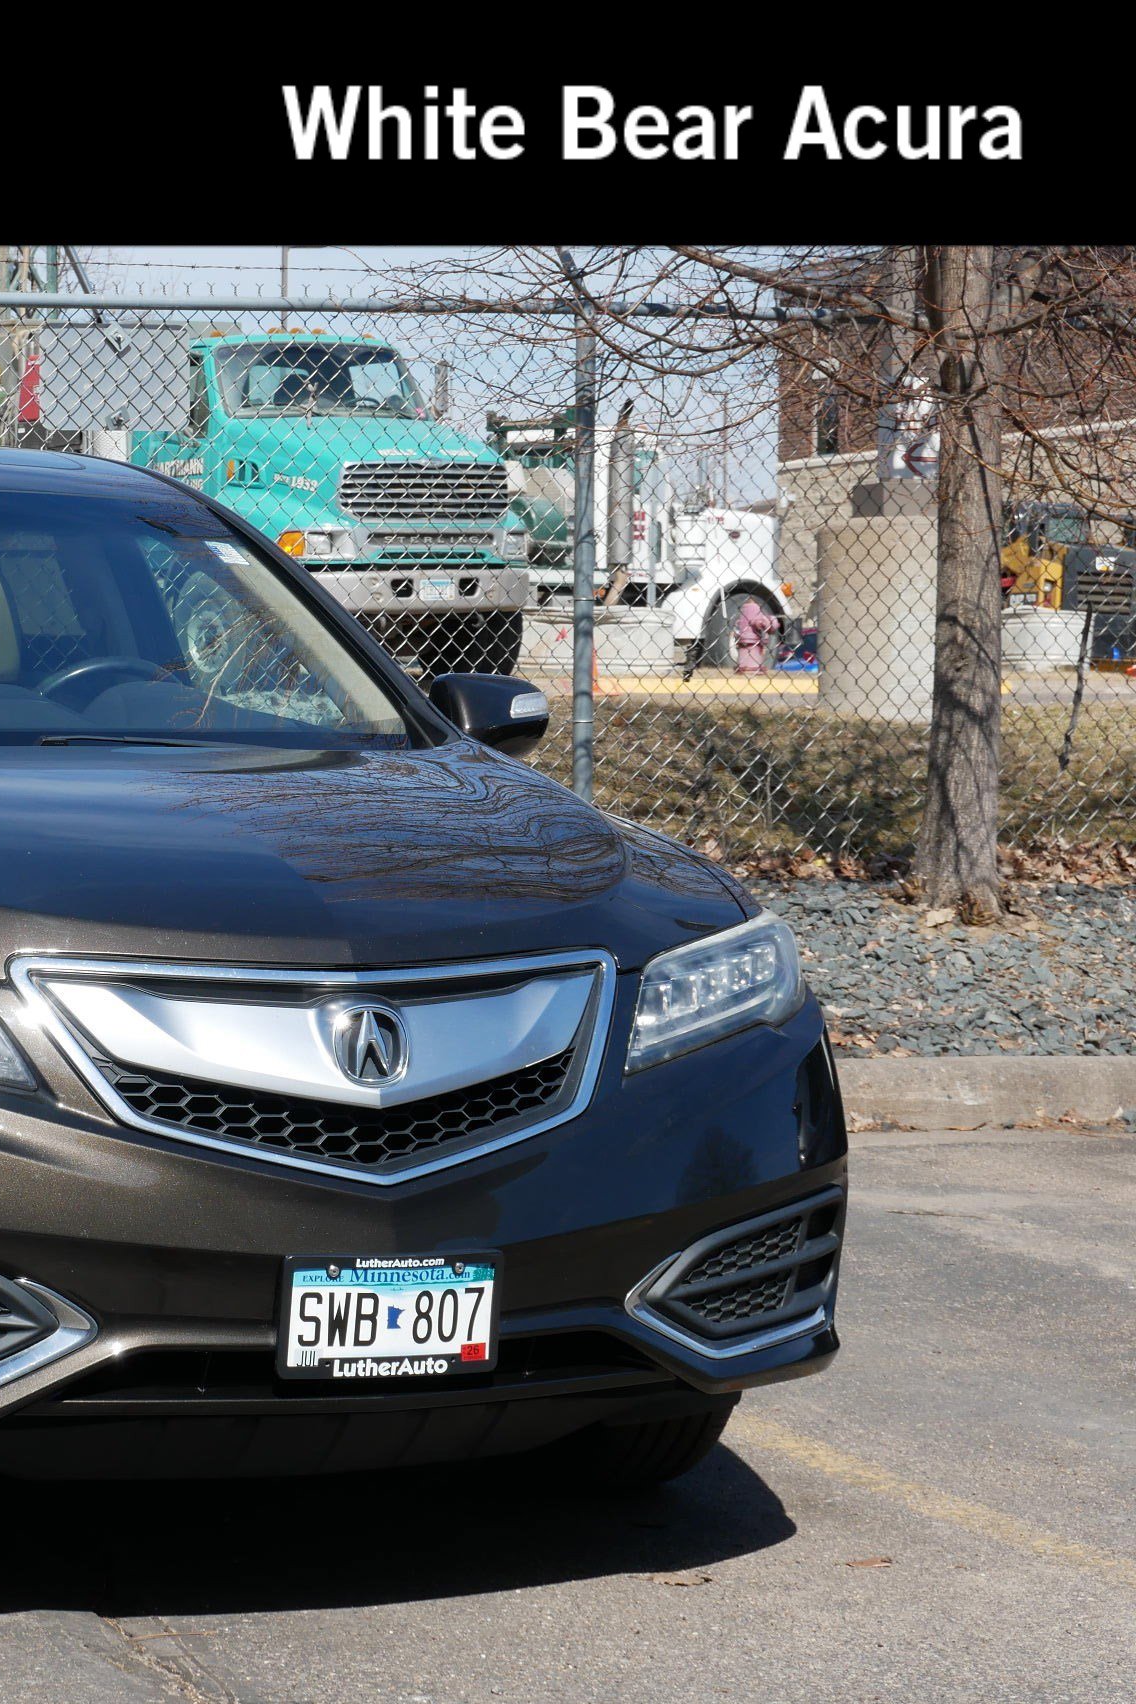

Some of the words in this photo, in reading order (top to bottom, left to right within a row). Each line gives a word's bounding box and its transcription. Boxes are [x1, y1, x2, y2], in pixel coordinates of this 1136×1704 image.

[384, 535, 480, 544] STERLING
[356, 1257, 445, 1269] LutherAuto.com
[297, 1291, 380, 1347] SWB
[412, 1287, 486, 1345] 807
[466, 1345, 480, 1356] 26
[332, 1357, 448, 1377] LutherAuto
